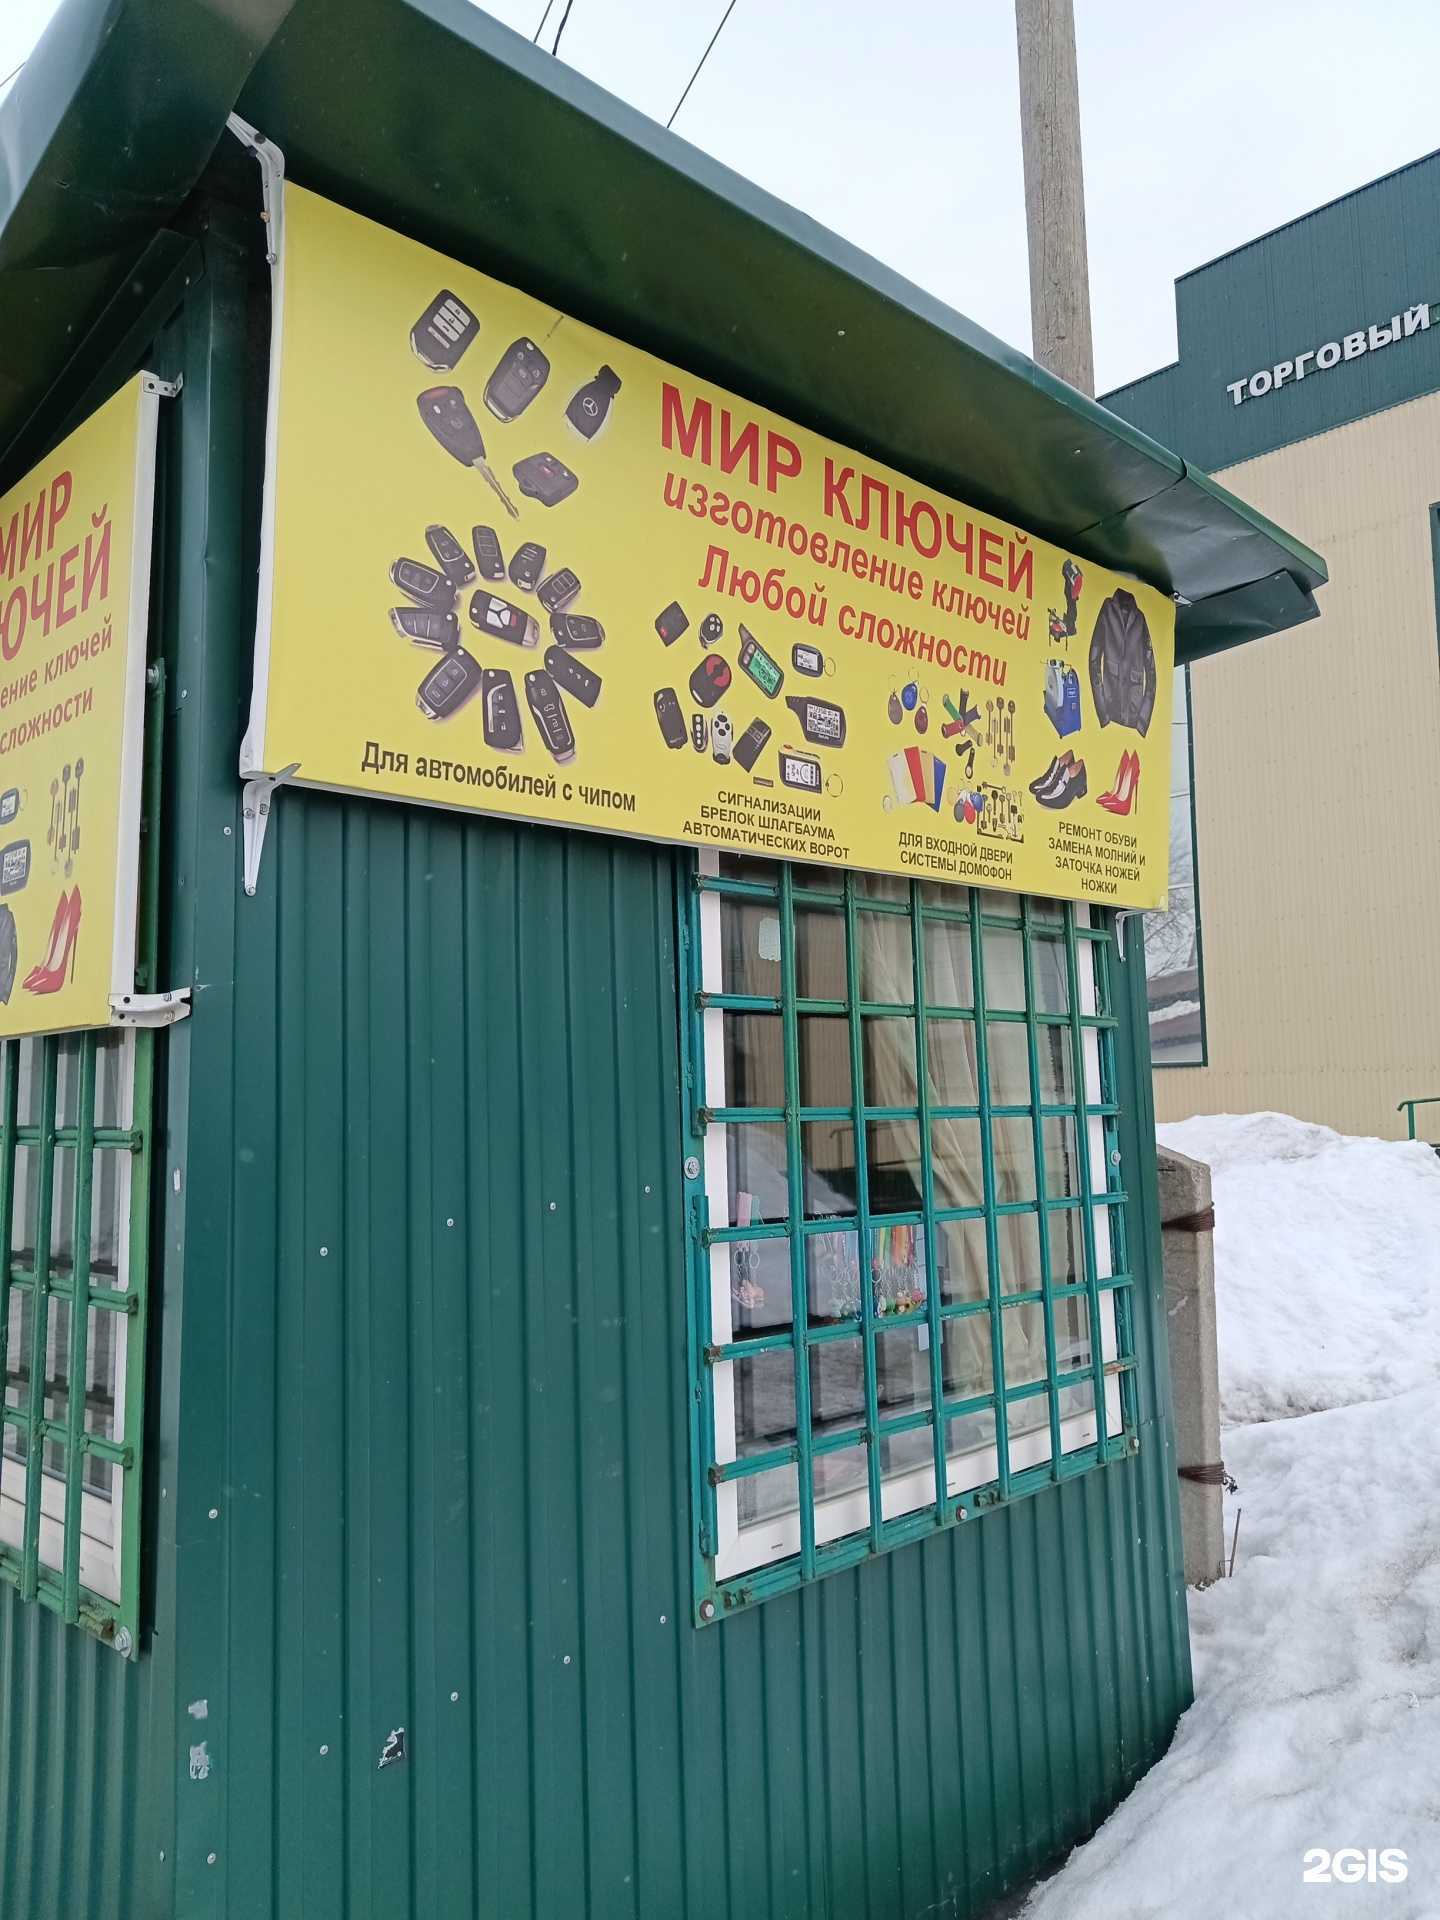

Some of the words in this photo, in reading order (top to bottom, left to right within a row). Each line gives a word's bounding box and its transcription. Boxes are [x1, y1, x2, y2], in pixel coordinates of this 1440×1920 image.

[1226, 303, 1431, 405] ТОРГОВЫЙ
[661, 382, 802, 494] МИР
[823, 456, 1034, 600] КЛЮЧЕЙ
[663, 472, 923, 600] изготовление
[931, 579, 1031, 641] ключей
[698, 544, 828, 626] Любой
[838, 604, 1007, 686] сложности
[44, 613, 112, 684] ключей
[0, 687, 93, 755] сложности
[361, 741, 409, 774] Для
[415, 756, 556, 799] автомобилей
[562, 783, 573, 801] с
[579, 785, 636, 812] чипом
[700, 805, 755, 827] БРЕЛОК
[758, 815, 836, 841] ШЛАГБАУМА
[717, 790, 821, 821] СИГНАЛИЗАЦИИ
[682, 821, 807, 853] АВТОМАТИЧЕСКИХ
[809, 842, 850, 860] ВОРОТ
[899, 831, 923, 848] ДЛЯ
[925, 839, 978, 858] ВХОДНОЙ
[979, 847, 1013, 865] ДВЕРИ
[1048, 837, 1092, 857] ЗАМЕНА
[1095, 845, 1137, 865] МОЛНИЙ
[1139, 855, 1146, 866] И
[1058, 821, 1102, 841] РЕМОНТ
[1104, 832, 1137, 849] ОБУВИ
[900, 851, 957, 872] СИСТЕМЫ
[959, 862, 1012, 881] ДОМОФОН
[1055, 855, 1103, 876] ЗАТОЧКА
[1105, 864, 1140, 882] НОЖЕЙ
[1081, 878, 1118, 895] НОЖКИ
